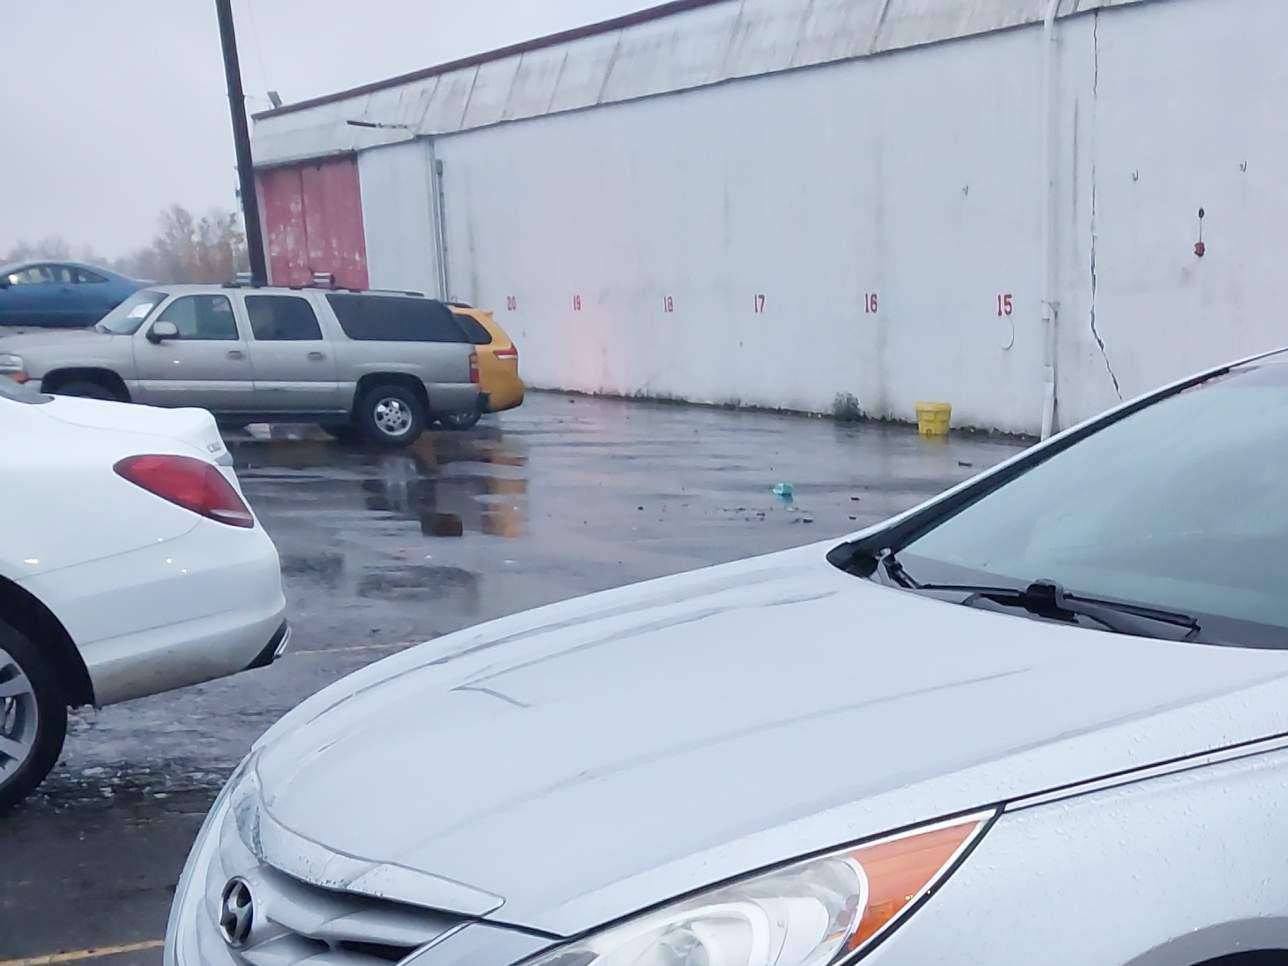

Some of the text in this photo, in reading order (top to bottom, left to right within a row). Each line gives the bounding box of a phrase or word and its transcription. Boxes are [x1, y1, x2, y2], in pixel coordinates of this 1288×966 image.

[663, 296, 674, 313] 18
[754, 294, 766, 313] 17
[865, 293, 878, 313] 16
[997, 294, 1013, 317] 15
